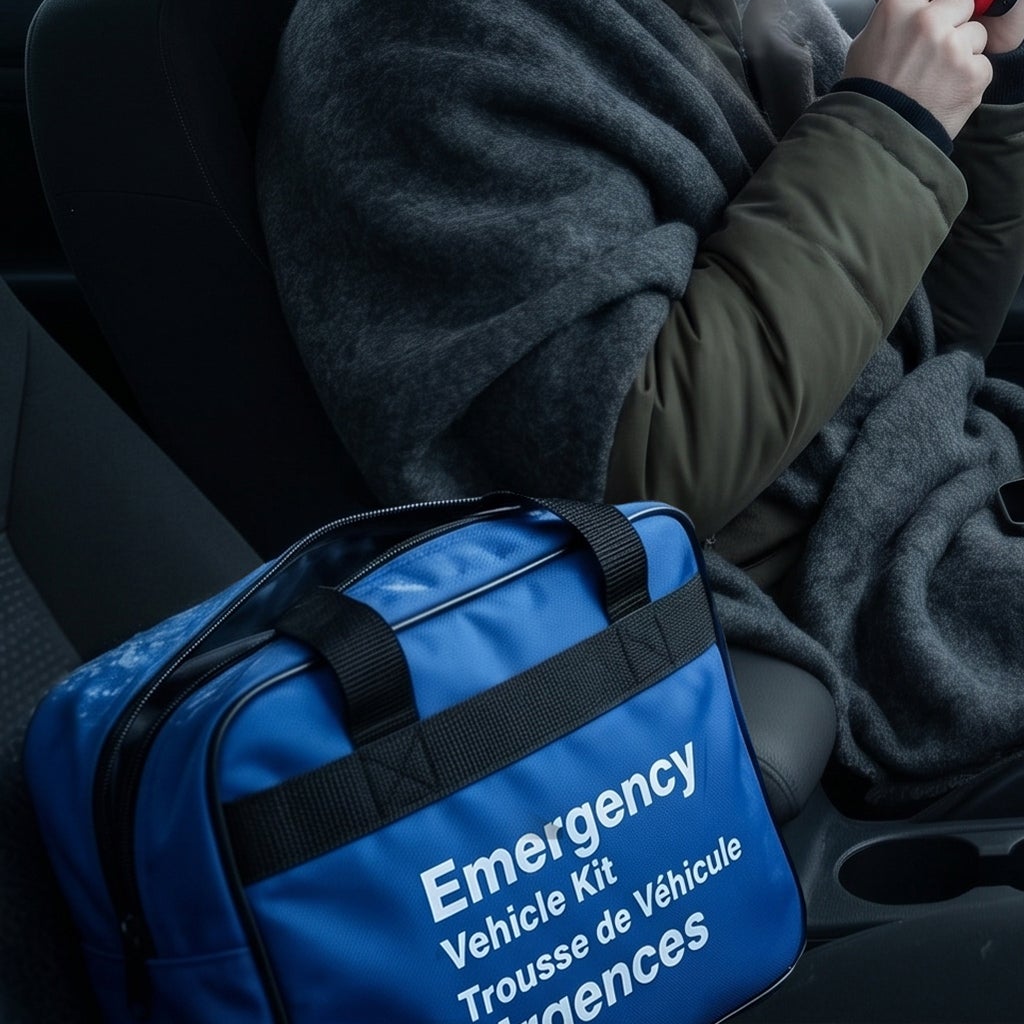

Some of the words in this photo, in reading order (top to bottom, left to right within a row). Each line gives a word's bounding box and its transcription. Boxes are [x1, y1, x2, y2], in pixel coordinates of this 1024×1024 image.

[420, 741, 696, 923] Emergency
[440, 890, 566, 969] Vehicle
[571, 856, 618, 903] Kit
[457, 936, 590, 1022] Trousse
[596, 908, 632, 945] de
[633, 836, 743, 918] Véhicule
